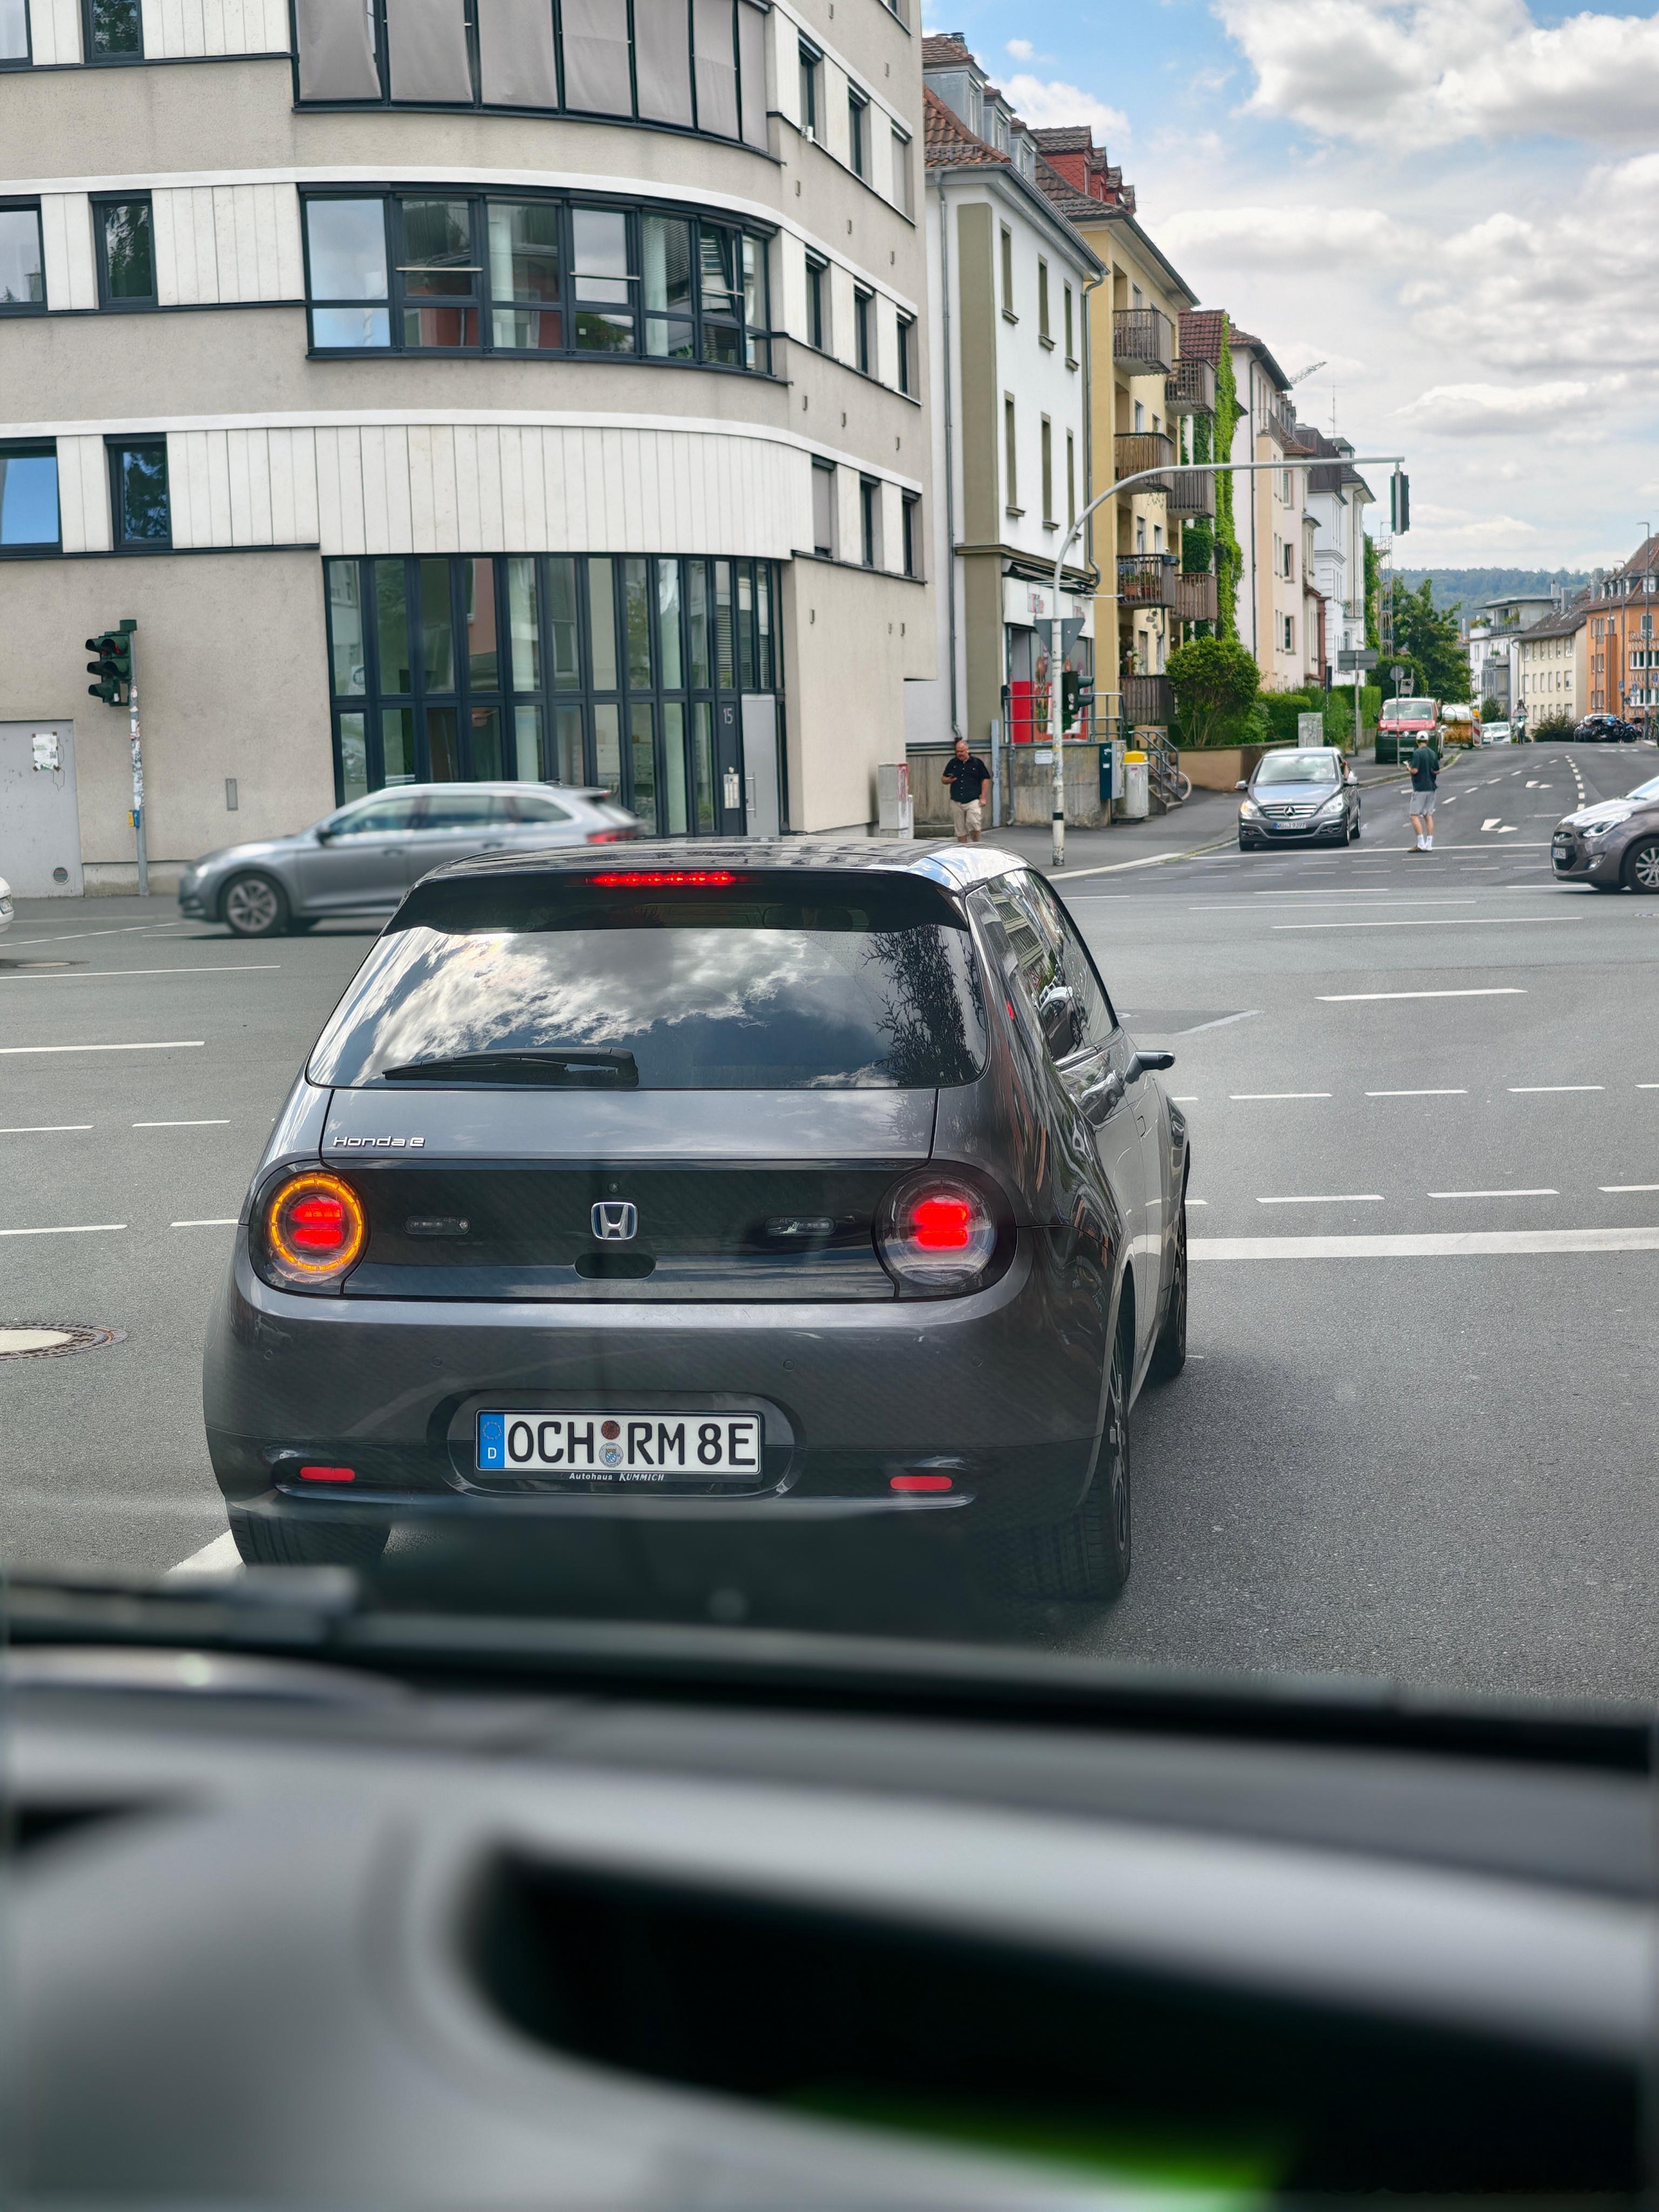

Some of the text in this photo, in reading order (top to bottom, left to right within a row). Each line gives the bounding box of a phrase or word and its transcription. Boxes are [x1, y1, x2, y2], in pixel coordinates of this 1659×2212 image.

[723, 708, 733, 724] 15
[333, 1136, 406, 1147] Honda
[508, 1421, 594, 1464] OCH
[628, 1422, 685, 1465] RM
[697, 1422, 756, 1466] 8E
[488, 1447, 497, 1459] D
[569, 1472, 613, 1480] Autohaus
